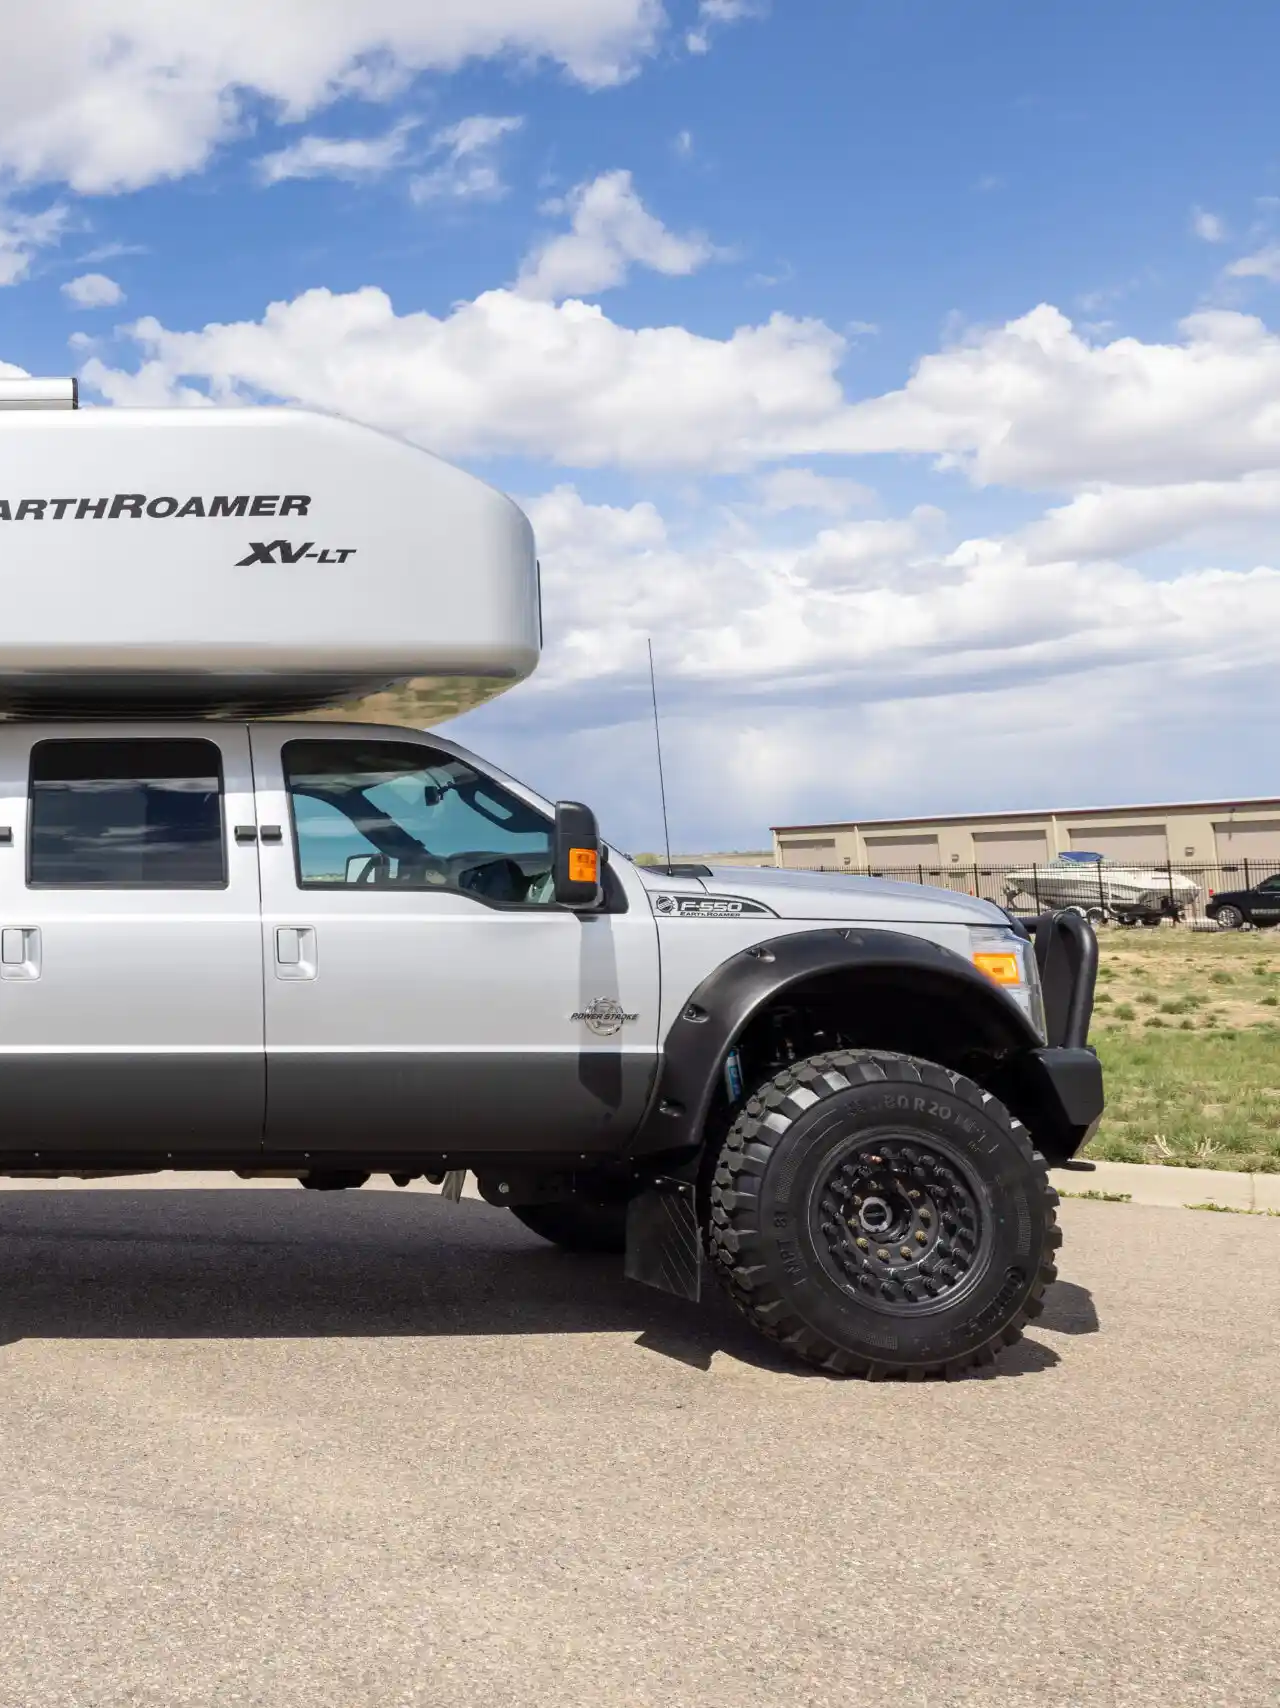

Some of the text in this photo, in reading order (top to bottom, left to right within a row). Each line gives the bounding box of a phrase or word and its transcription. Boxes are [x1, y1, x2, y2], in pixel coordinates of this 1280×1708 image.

[233, 539, 358, 567] XV-LT
[680, 901, 743, 912] F-550
[570, 1012, 602, 1020] POWER
[927, 1101, 952, 1120] 20
